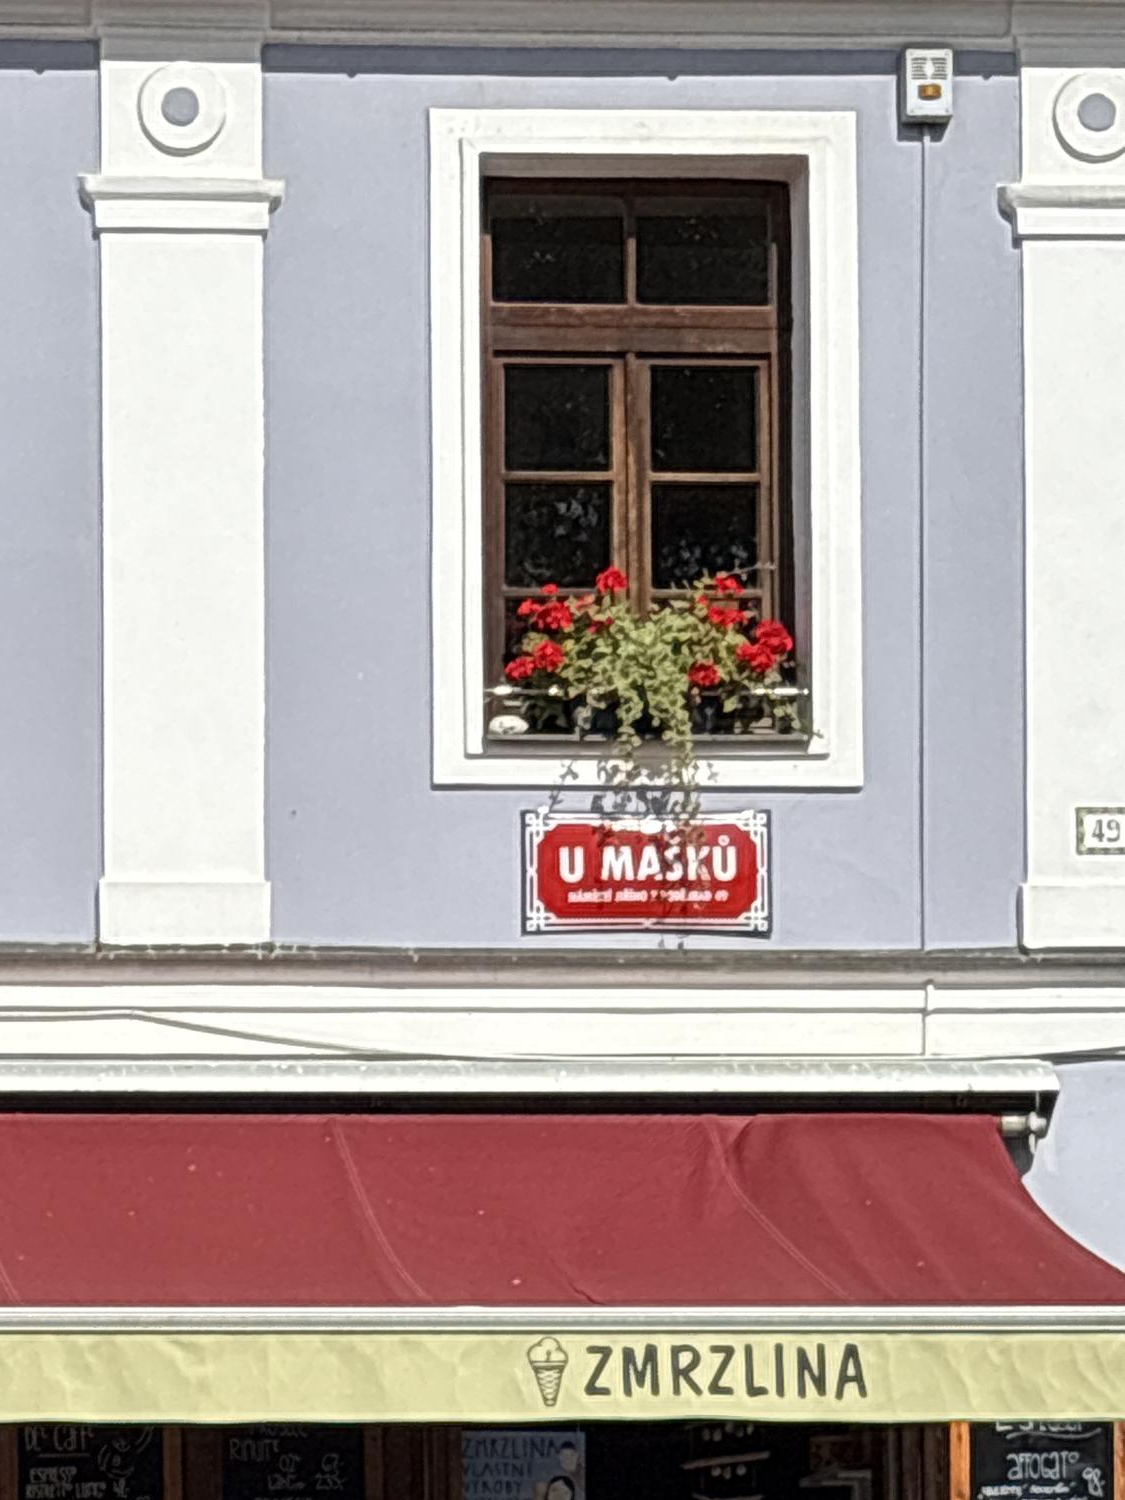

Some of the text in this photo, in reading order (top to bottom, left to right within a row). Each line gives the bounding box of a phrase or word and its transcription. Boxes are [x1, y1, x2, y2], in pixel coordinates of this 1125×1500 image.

[559, 834, 737, 883] U MAŠKŮ
[583, 1342, 868, 1401] ZMRZLINA
